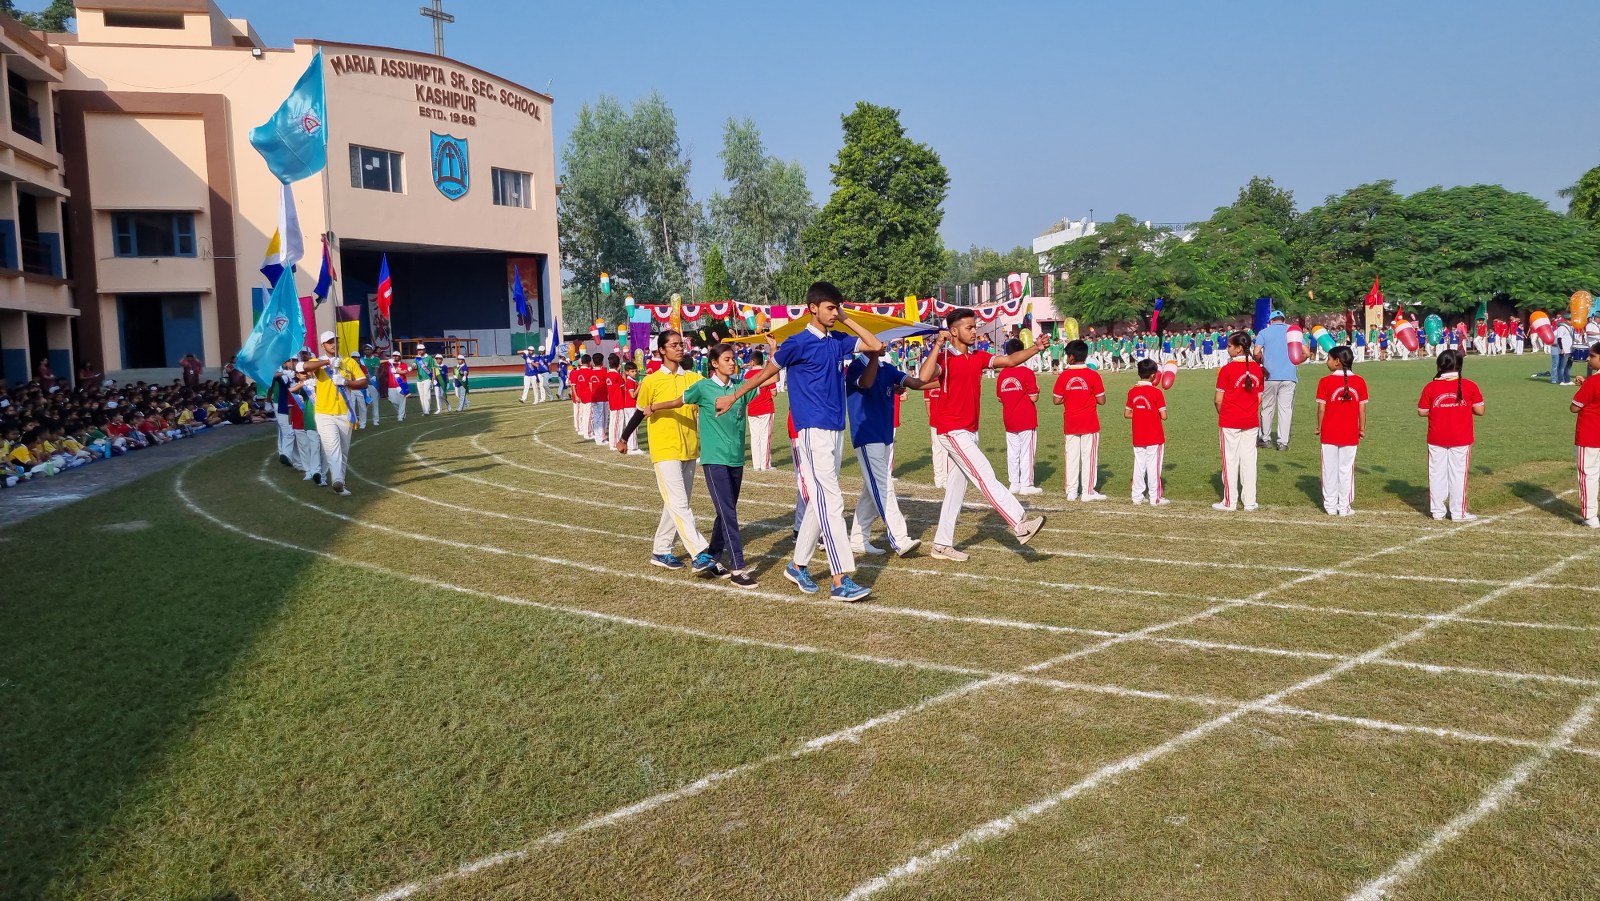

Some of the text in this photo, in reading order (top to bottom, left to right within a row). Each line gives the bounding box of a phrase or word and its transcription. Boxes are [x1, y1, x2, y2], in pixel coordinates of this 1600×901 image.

[330, 55, 542, 121] MARIA ASSUMPTA SR. SEC. SCHOOL
[415, 84, 477, 112] KASHIPUR
[419, 106, 477, 126] ESTD. 1988
